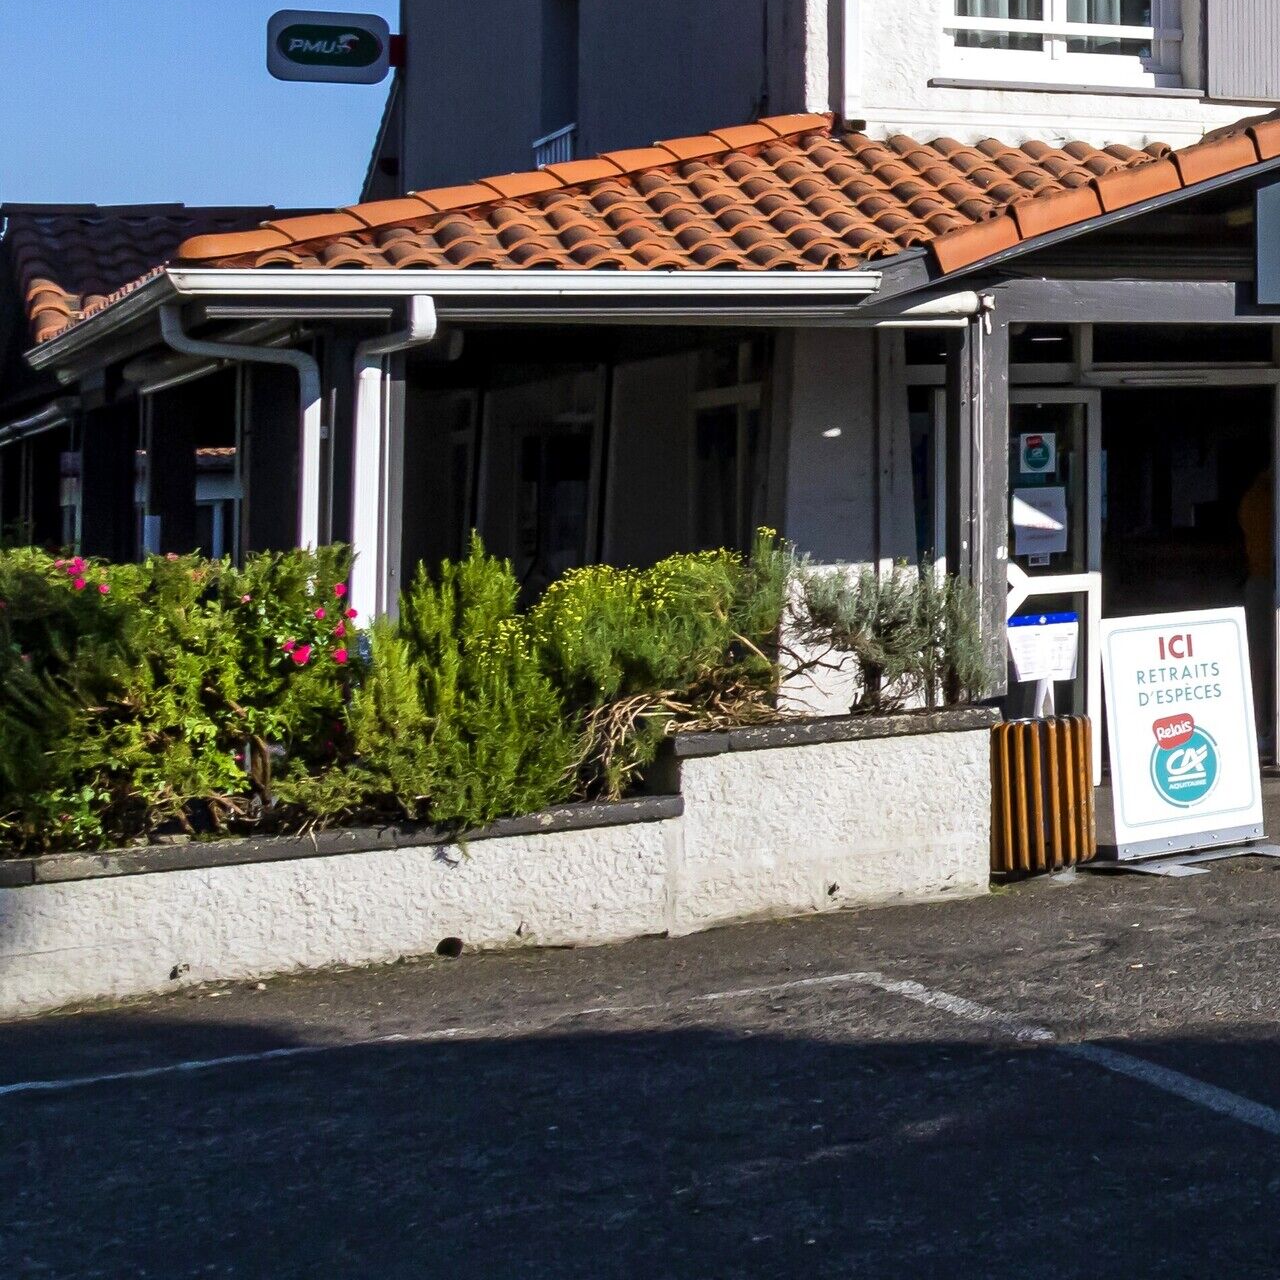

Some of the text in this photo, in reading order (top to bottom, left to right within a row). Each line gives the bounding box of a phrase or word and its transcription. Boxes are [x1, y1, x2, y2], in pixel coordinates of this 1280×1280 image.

[287, 37, 336, 54] PMU
[1158, 634, 1193, 660] ICI
[1136, 662, 1220, 685] RETRAITS
[1138, 683, 1222, 706] D'ESPÈCES
[1156, 720, 1192, 741] Relais
